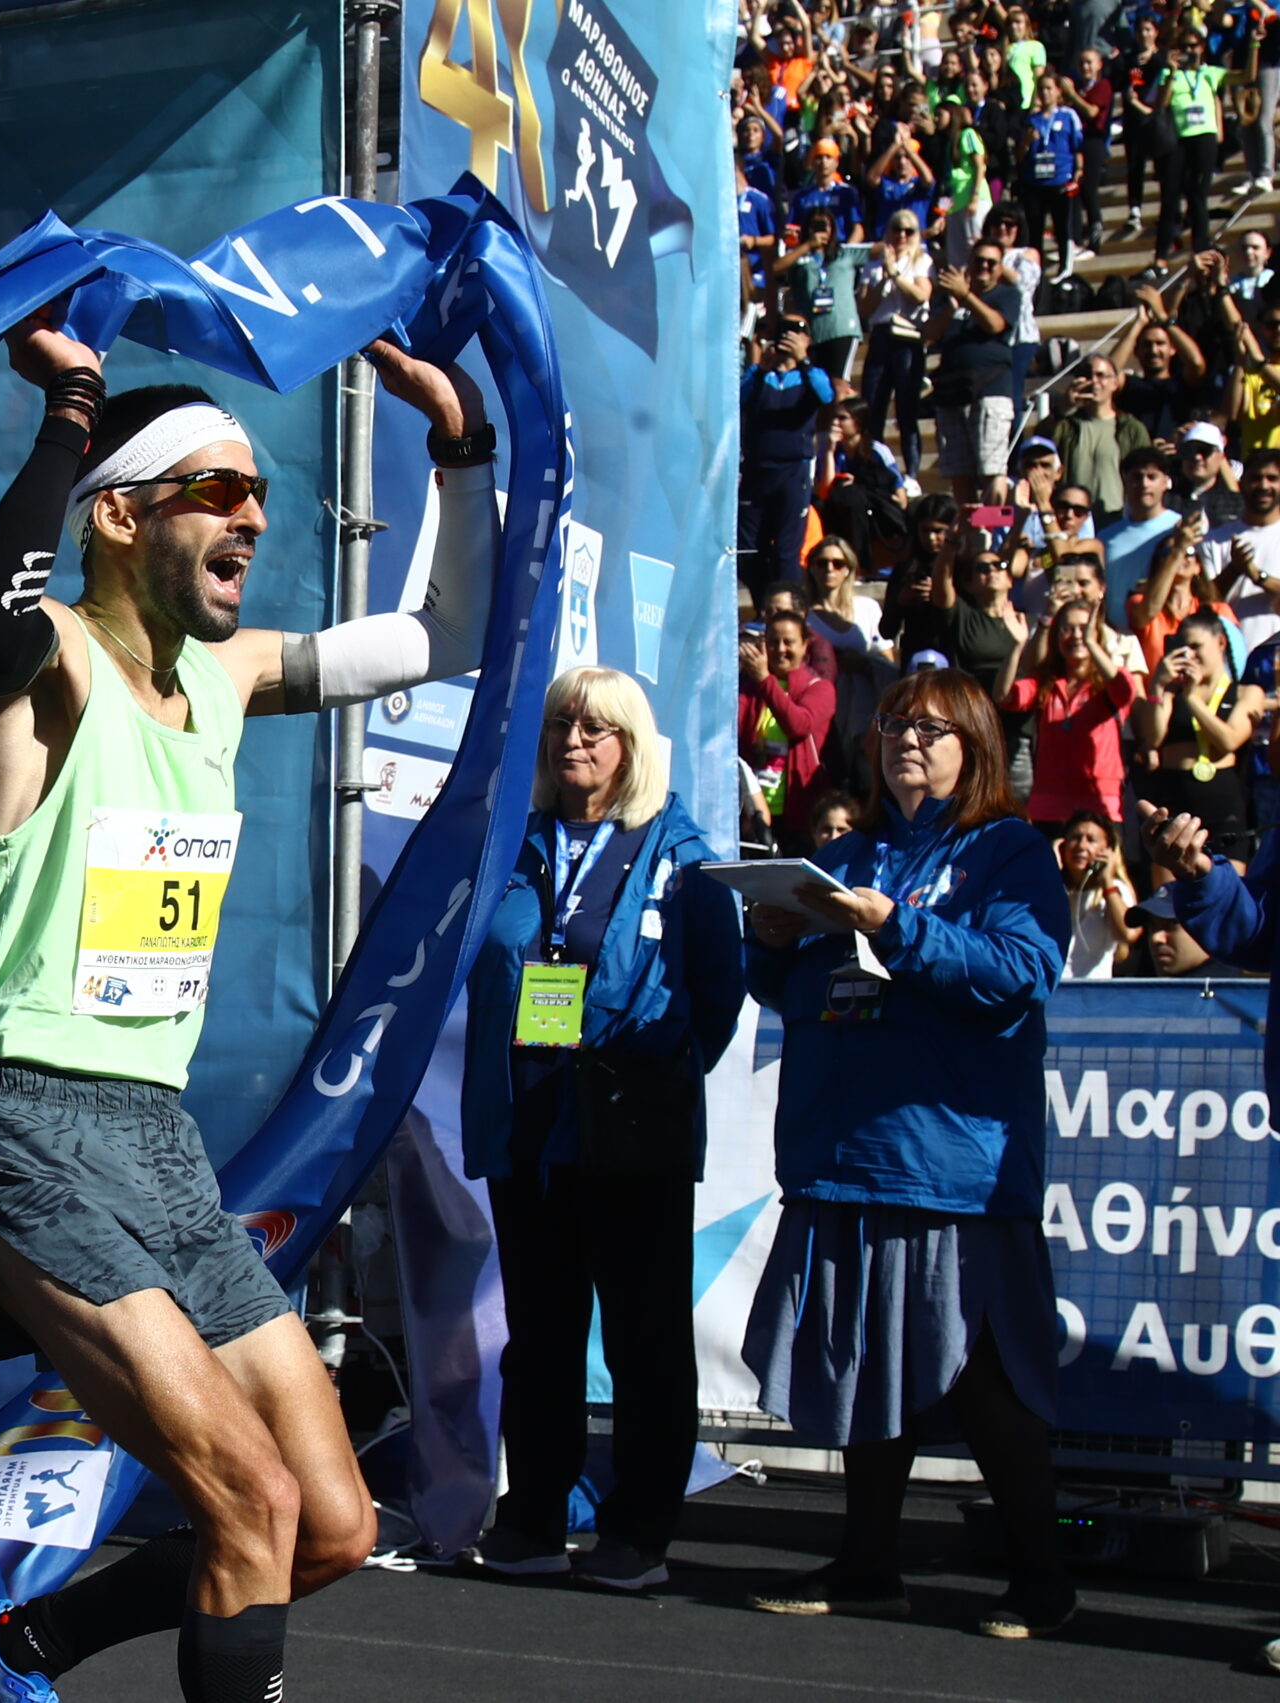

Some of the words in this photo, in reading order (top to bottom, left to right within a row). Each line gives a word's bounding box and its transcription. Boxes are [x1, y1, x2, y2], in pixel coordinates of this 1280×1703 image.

[568, 1, 649, 116] ΜΑΡΑΘΩΝΙΟΣ
[575, 49, 627, 126] ΑΘΗΝΑΣ
[561, 68, 570, 85] Ο
[571, 80, 636, 155] ΑΥΘΕΝΤΙΚΟΣ
[159, 880, 201, 932] 51
[96, 954, 148, 966] ΑΥΘΕΝΤΙΚΟΣ
